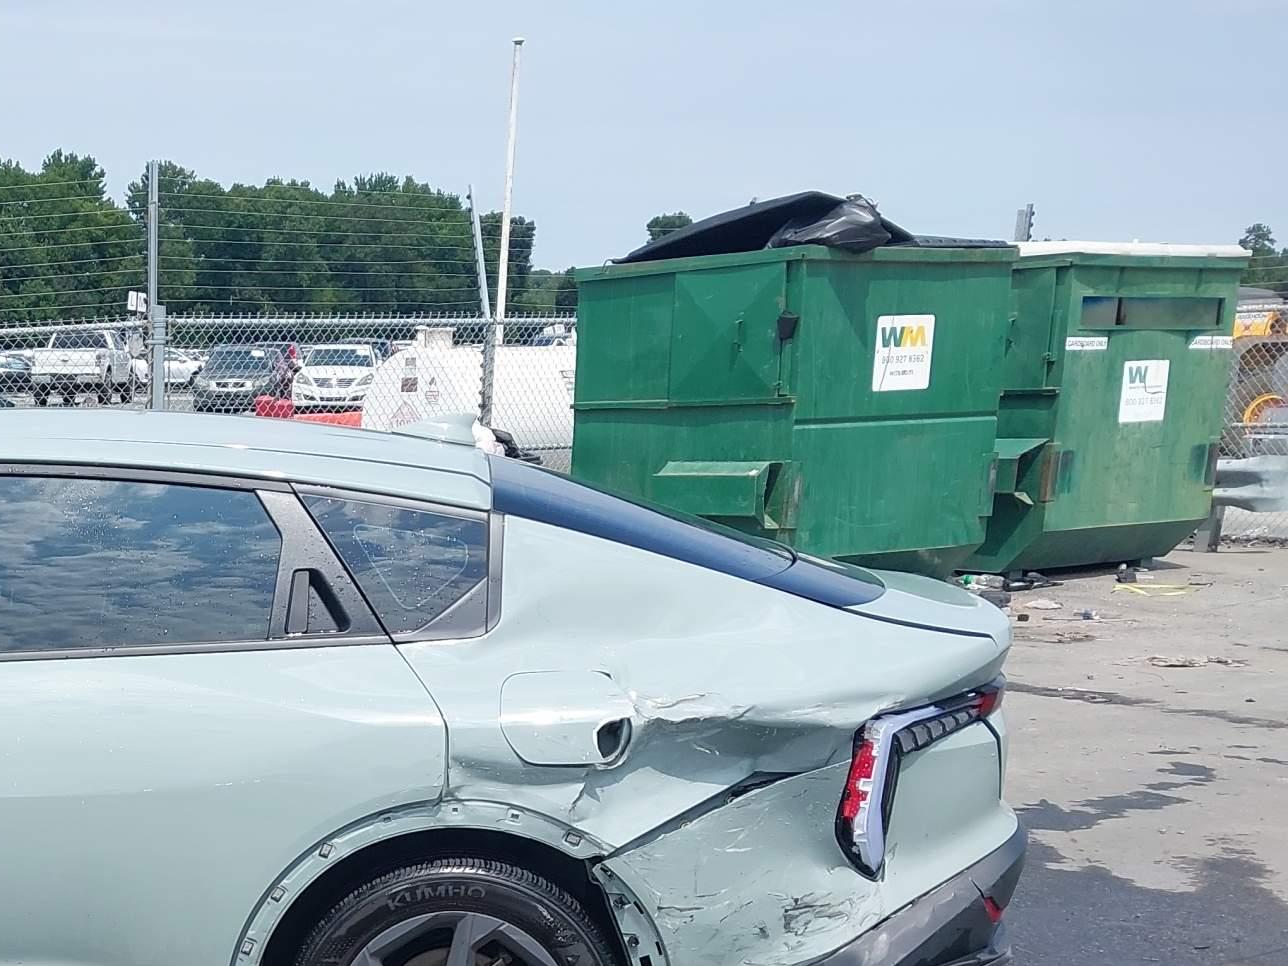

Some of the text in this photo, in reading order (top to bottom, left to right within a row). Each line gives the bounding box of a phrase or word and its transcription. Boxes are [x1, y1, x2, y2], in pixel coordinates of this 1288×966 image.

[881, 325, 926, 348] WM
[895, 355, 907, 364] 927
[386, 883, 486, 911] KUMHO
